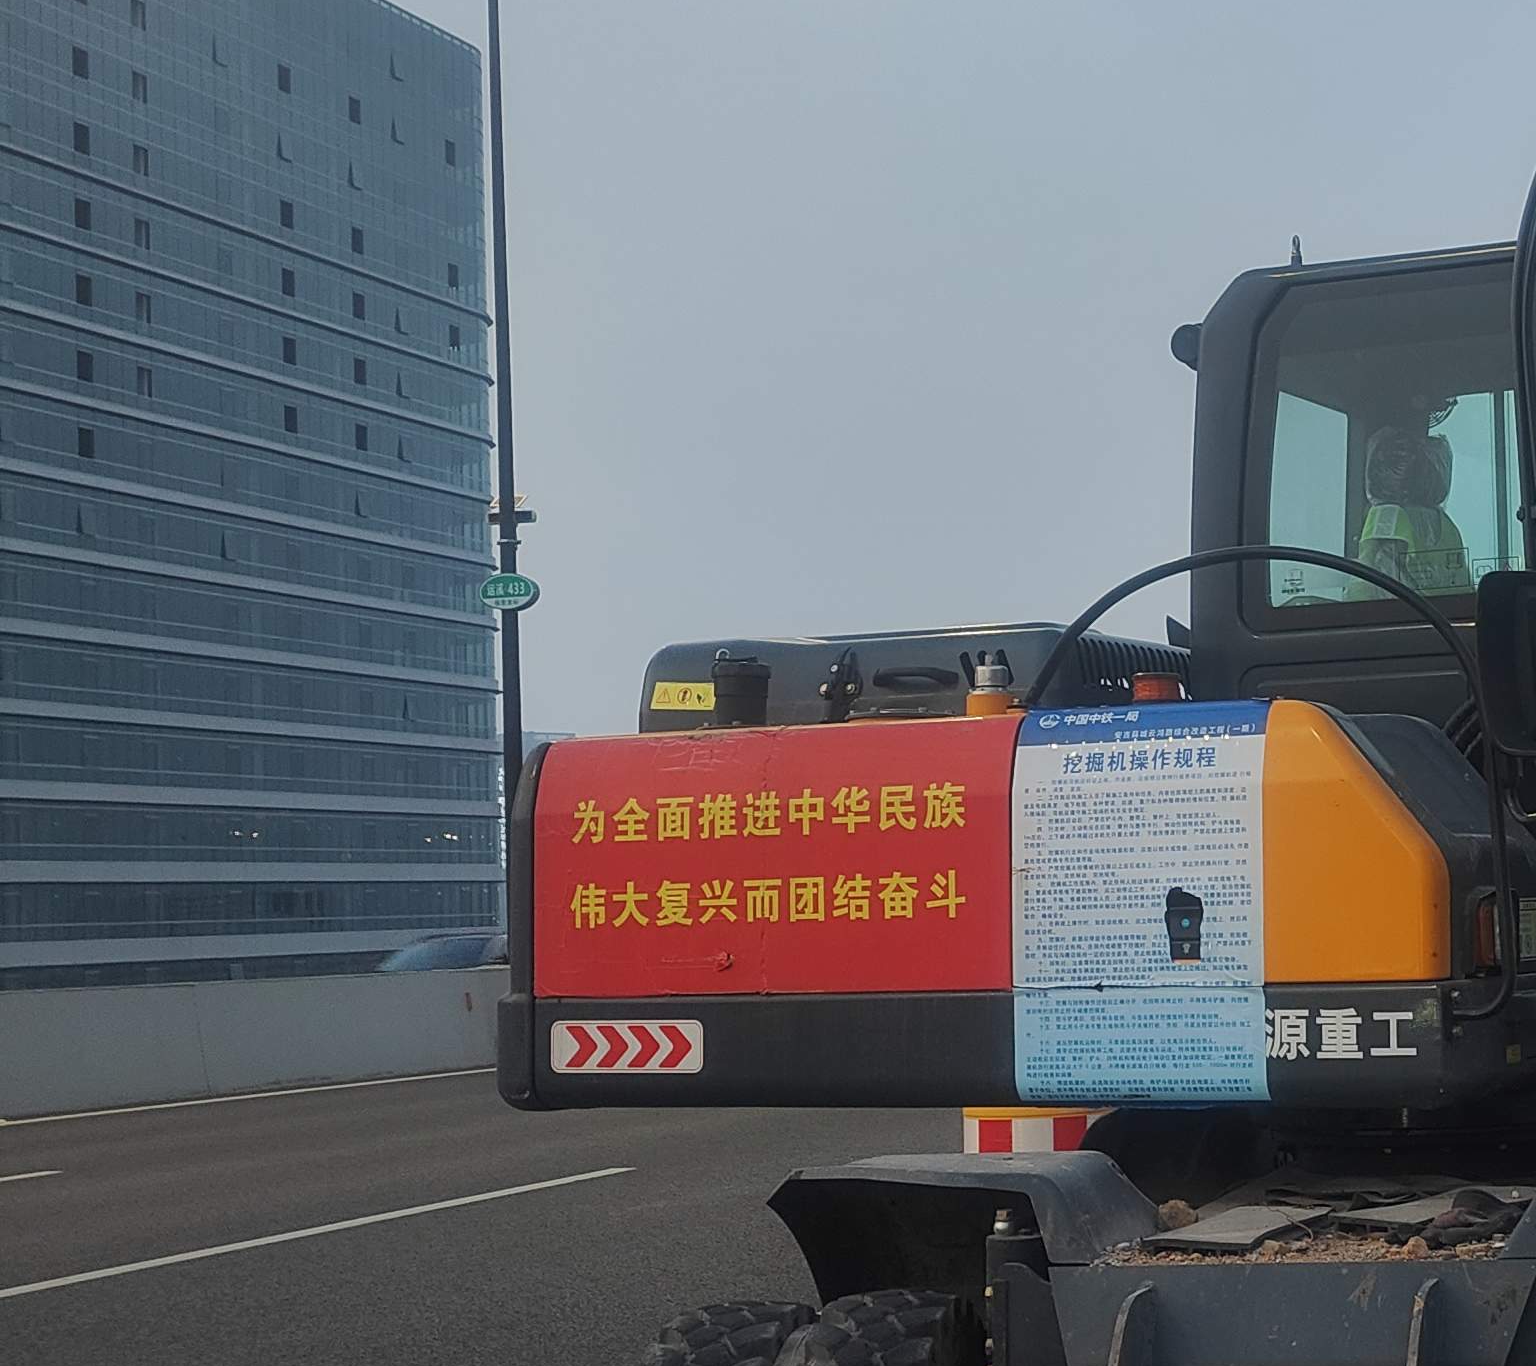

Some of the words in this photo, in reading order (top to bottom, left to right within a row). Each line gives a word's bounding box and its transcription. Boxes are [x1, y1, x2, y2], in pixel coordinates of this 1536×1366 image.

[508, 582, 525, 595] 433
[1063, 710, 1140, 726] 中国中铁一局
[1063, 745, 1217, 776] 挖掘机操作规程
[571, 782, 967, 844] 为全面推进中华民族
[569, 869, 967, 930] 伟大复兴而团结奋斗
[1265, 1007, 1418, 1061] 源重工
